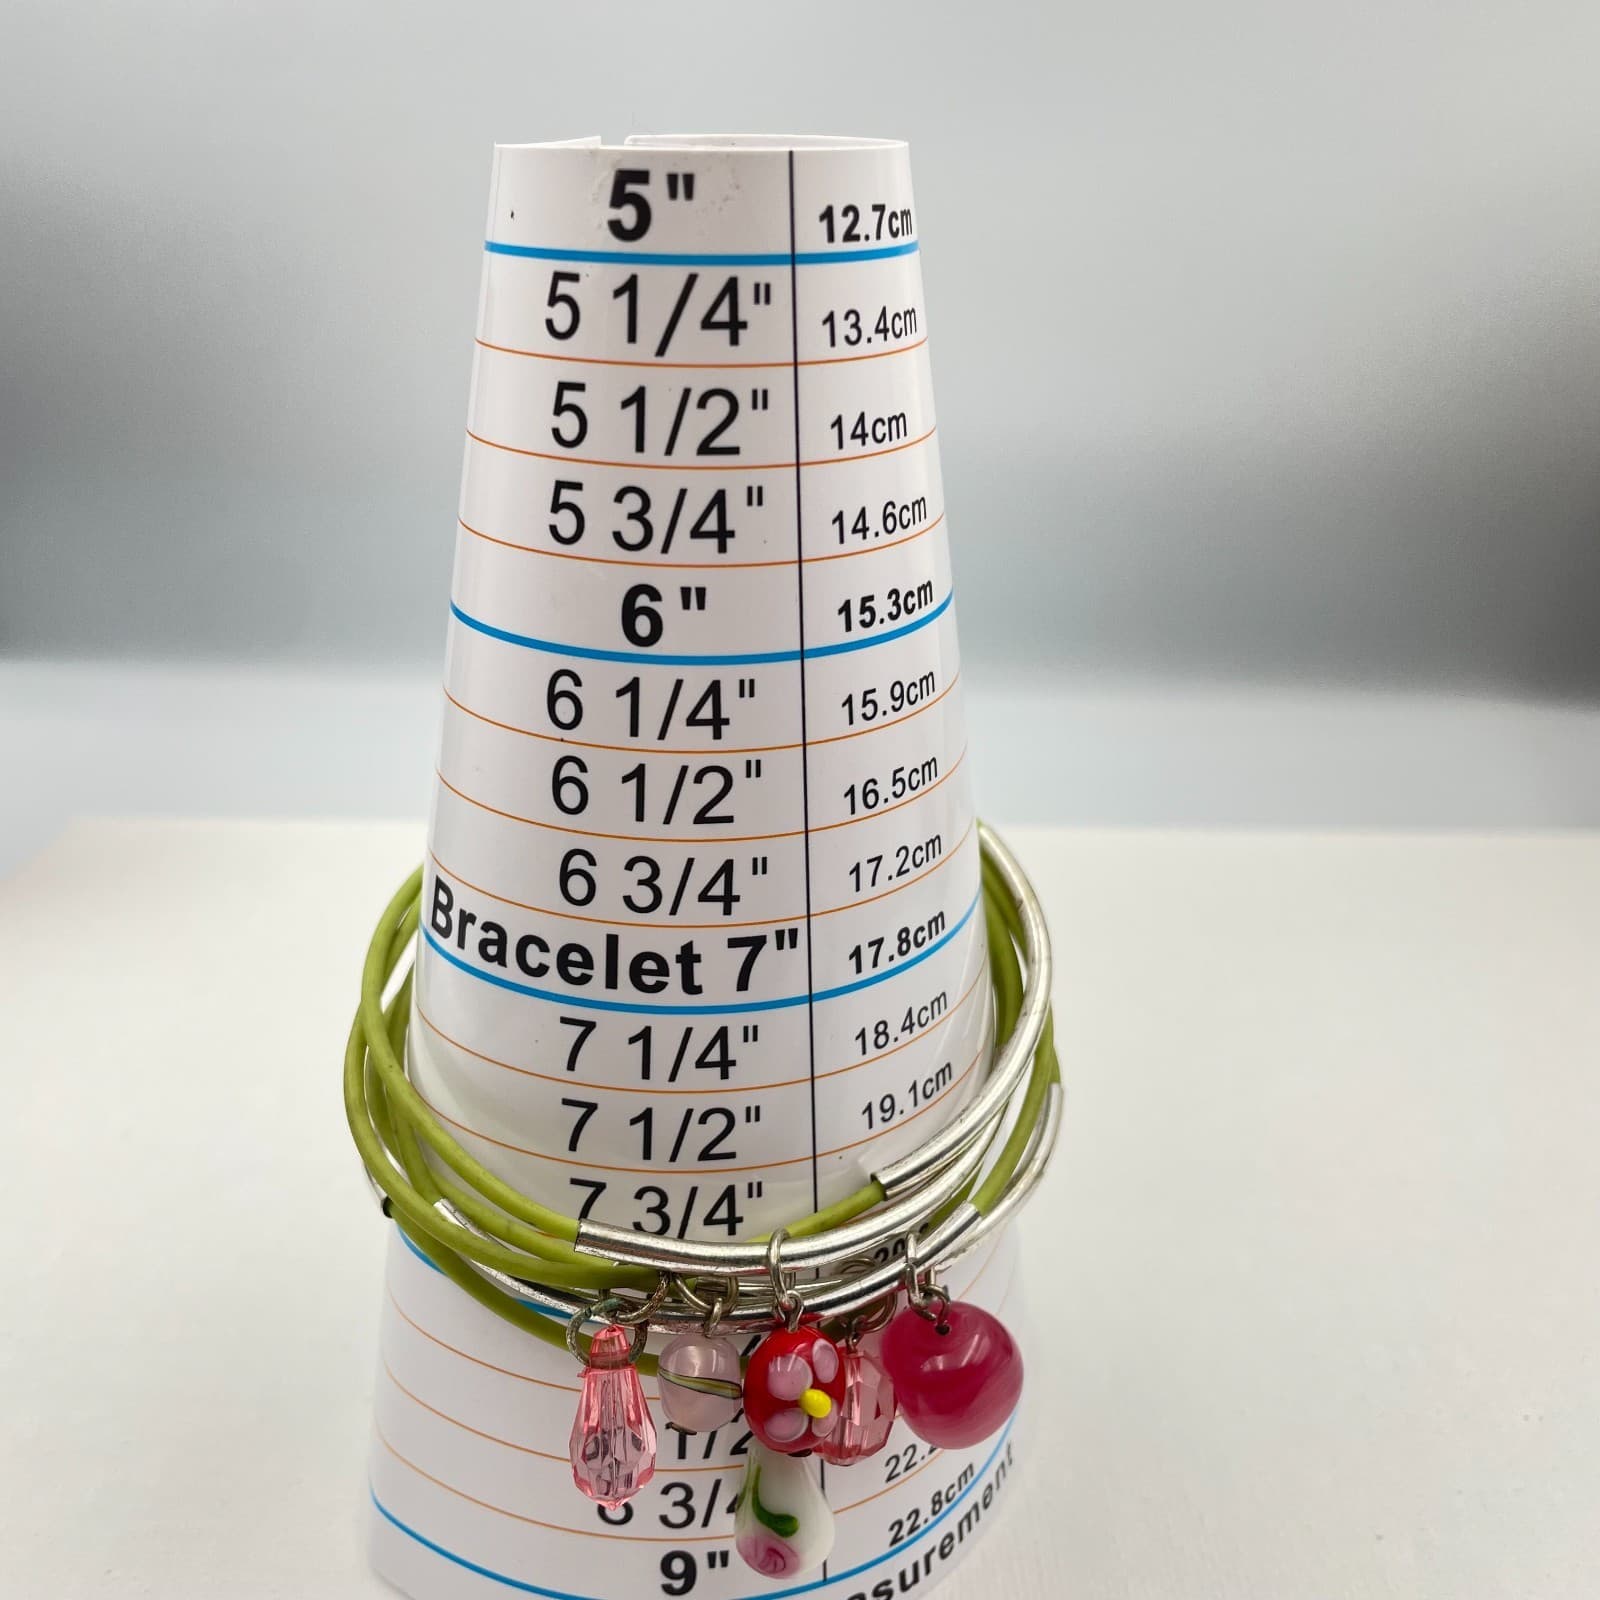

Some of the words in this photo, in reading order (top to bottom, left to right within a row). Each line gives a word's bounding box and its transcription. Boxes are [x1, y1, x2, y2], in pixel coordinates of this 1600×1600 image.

[607, 168, 695, 243] 5"
[819, 203, 914, 244] 12.7cm
[544, 270, 581, 341] 5
[612, 272, 771, 358] 1/4"
[822, 306, 917, 348] 13.4cm
[551, 380, 588, 449] 5
[620, 385, 769, 457] 1/2"
[830, 411, 908, 450] 14cm
[548, 479, 586, 546] 5
[611, 485, 764, 555] 3/4"
[831, 493, 928, 545] 14.6cm
[620, 583, 707, 648] 6"
[837, 578, 934, 633] 15.3cm
[546, 668, 584, 731] 6
[615, 678, 756, 741] 1/4"
[841, 669, 936, 726] 15.9cm
[551, 754, 589, 816] 6
[621, 758, 763, 826] 1/2"
[843, 755, 939, 816] 16.5cm
[558, 848, 598, 907] 6
[622, 855, 769, 917] 3/4"
[848, 833, 943, 893] 17.2cm
[430, 875, 704, 996] Bracelet
[726, 927, 800, 993] 7"
[848, 907, 947, 976] 17.8cm
[559, 1015, 597, 1072] 7
[627, 1023, 760, 1083] 1/4"
[855, 989, 948, 1056] 18.4cm
[861, 1060, 953, 1130] 19.1cm
[560, 1097, 599, 1153] 7
[629, 1103, 762, 1163] 1/2"
[569, 1177, 608, 1224] 7
[631, 1180, 763, 1242] 3/4"
[884, 1443, 940, 1484] 22.
[888, 1461, 975, 1548] 22.8cm
[659, 1549, 731, 1598] 9"
